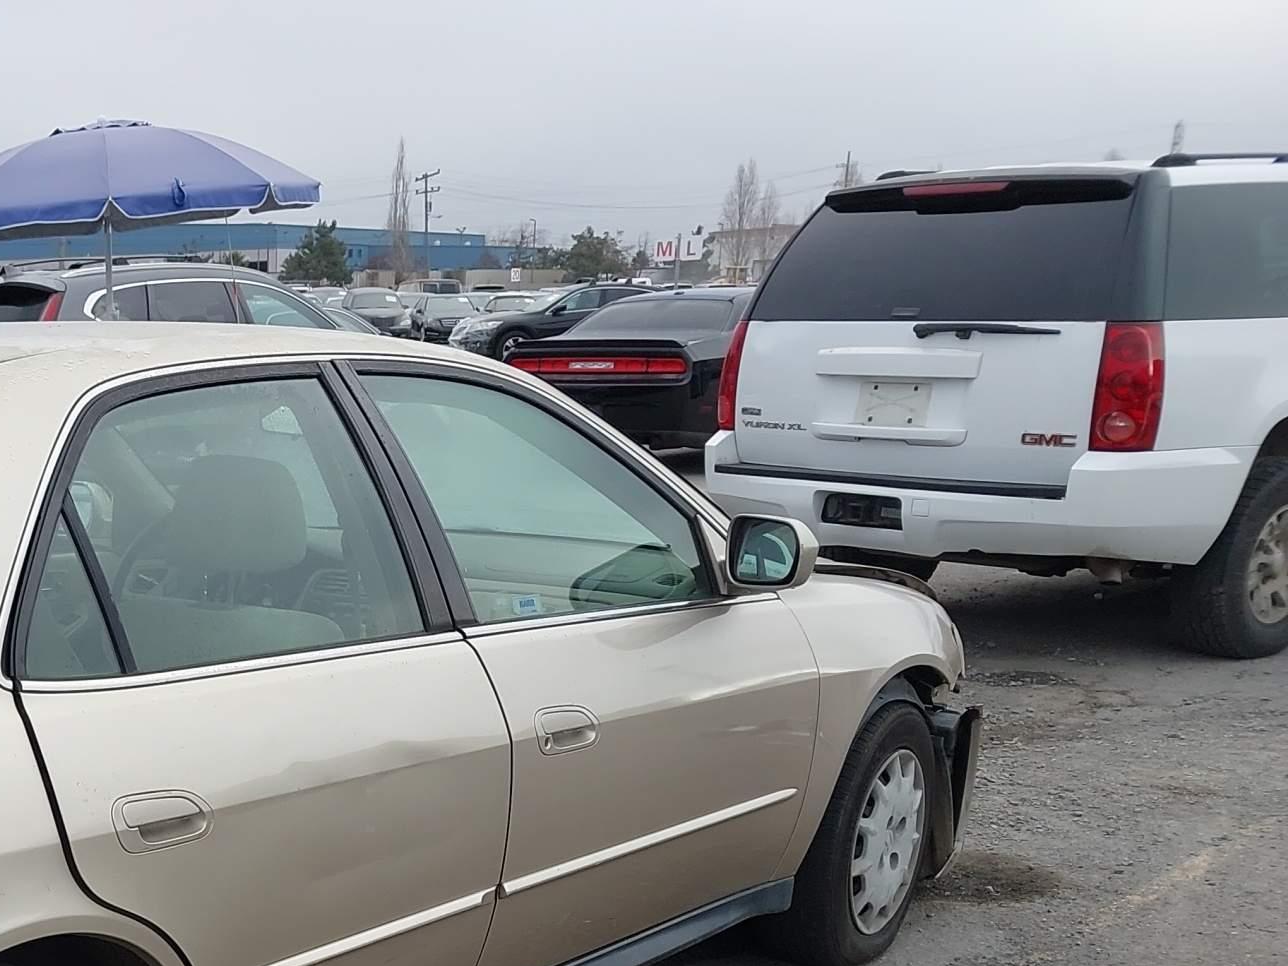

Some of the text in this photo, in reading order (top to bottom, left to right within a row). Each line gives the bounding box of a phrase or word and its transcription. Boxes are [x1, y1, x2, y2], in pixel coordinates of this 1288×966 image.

[657, 240, 696, 257] M L
[742, 420, 808, 431] YUKON XL
[1021, 433, 1077, 447] GMC
